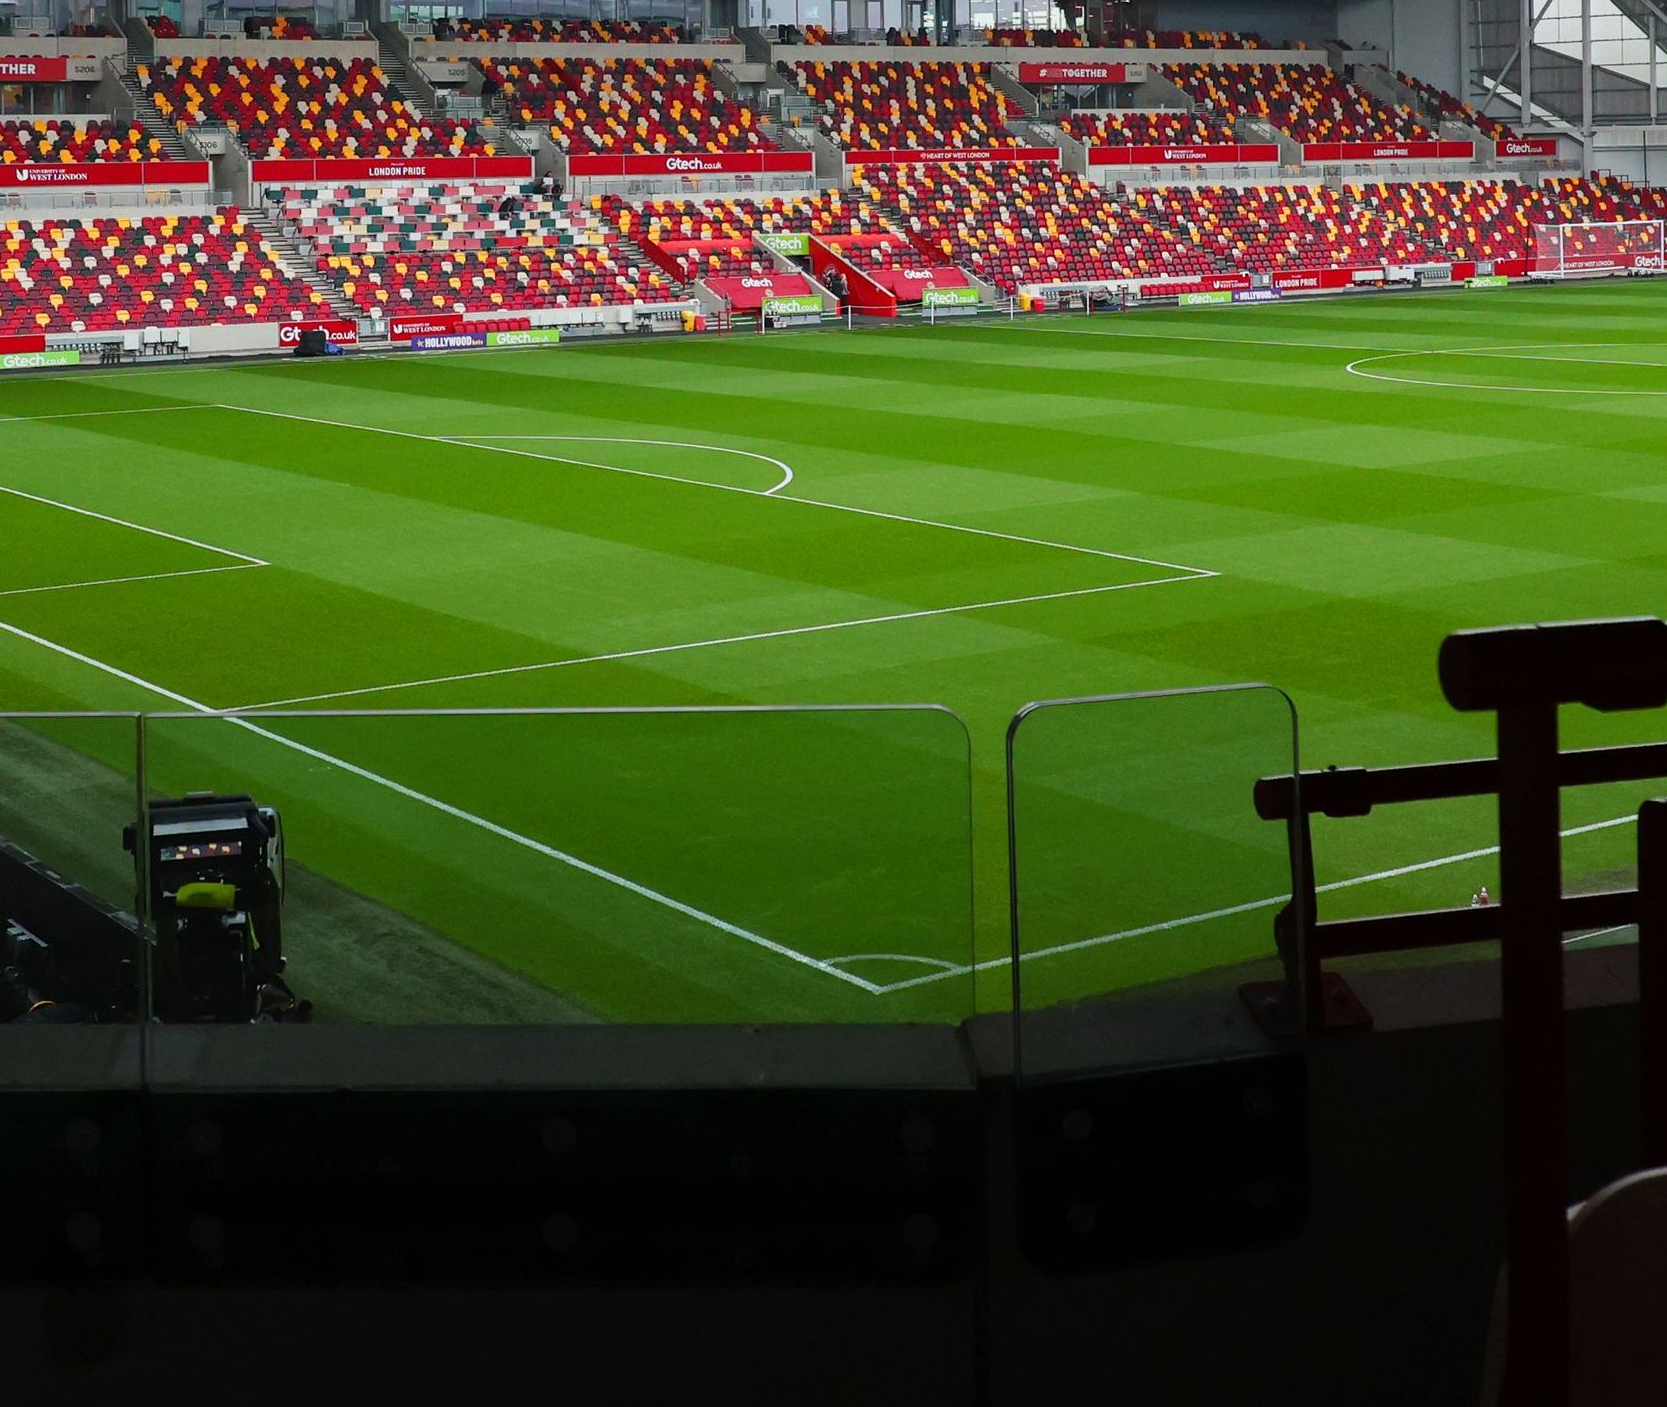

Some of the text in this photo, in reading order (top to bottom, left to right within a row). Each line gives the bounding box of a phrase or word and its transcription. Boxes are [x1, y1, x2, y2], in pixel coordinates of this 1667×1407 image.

[926, 151, 990, 160] HEART OF WEST LONDON
[1394, 148, 1409, 156] PRIDE
[666, 157, 723, 170] Gtech.co.uk
[54, 173, 88, 181] LONDON
[369, 166, 426, 177] LONDON PRIDE
[765, 236, 802, 251] Gtech
[904, 268, 933, 279] Gtech
[741, 277, 773, 288] Gtech
[1275, 277, 1318, 288] LONDON PRIDE
[280, 326, 357, 343] Gth.co.uk
[425, 325, 447, 333] LONDON
[496, 331, 550, 345] Gtech.co.uk
[3, 354, 68, 368] Gtech.co.uk
